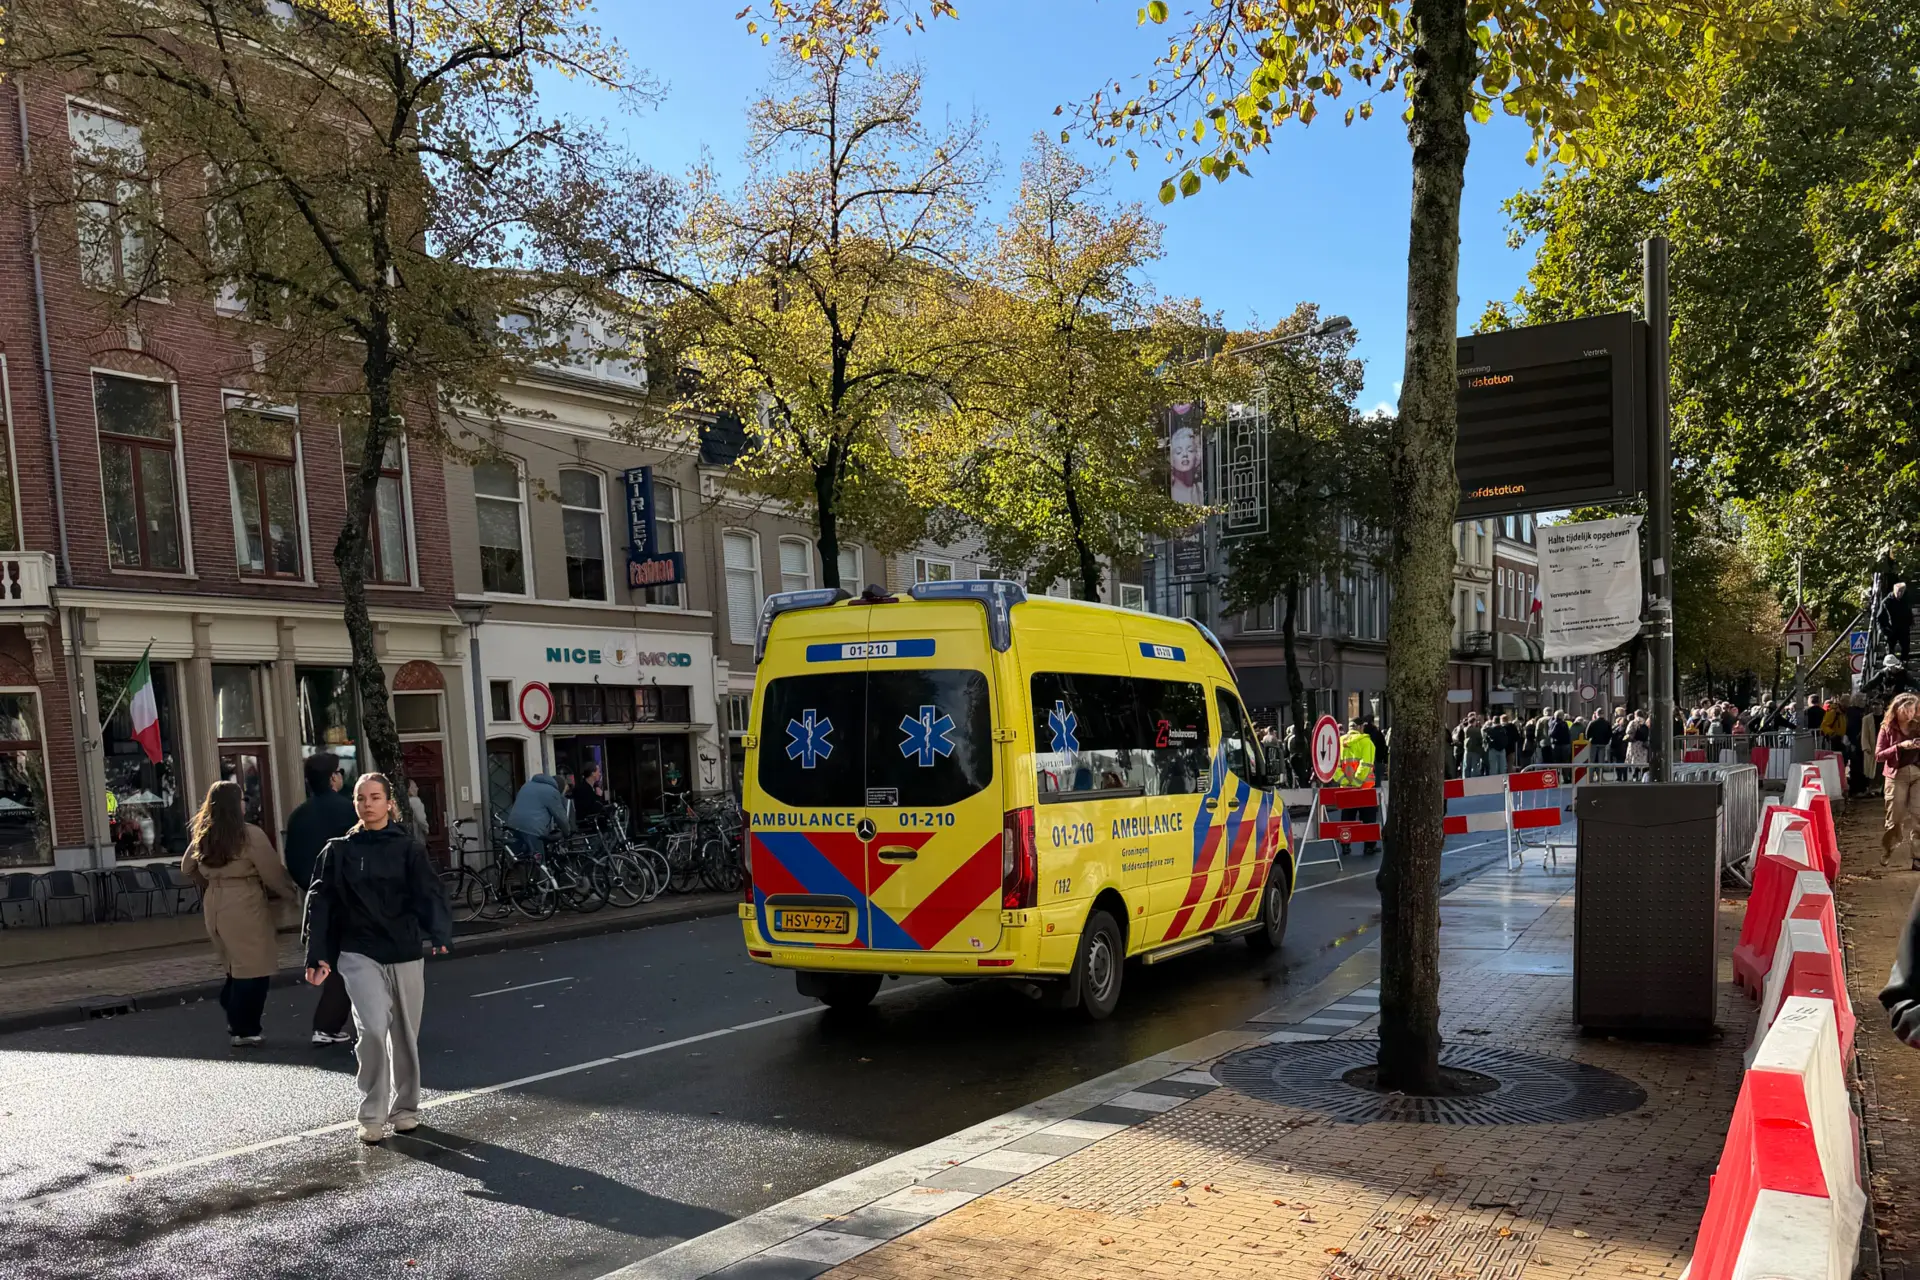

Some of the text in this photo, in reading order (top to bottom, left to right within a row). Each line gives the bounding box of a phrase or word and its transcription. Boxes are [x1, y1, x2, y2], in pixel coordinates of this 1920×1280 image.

[1582, 348, 1608, 357] Vertrek
[1458, 365, 1491, 376] stemming
[628, 469, 646, 552] GIRLEY
[1548, 528, 1630, 545] Halte tijdelijk opgeheven
[546, 647, 692, 667] NICE MOOD
[849, 644, 888, 656] 01-210
[751, 812, 855, 827] AMBULANCE
[899, 812, 955, 827] 01-210
[1112, 812, 1183, 840] AMBULANCE
[1052, 822, 1094, 848] 01-210
[1121, 846, 1148, 857] Groningen
[1058, 877, 1071, 894] 112
[785, 914, 843, 929] HSV-99-Z
